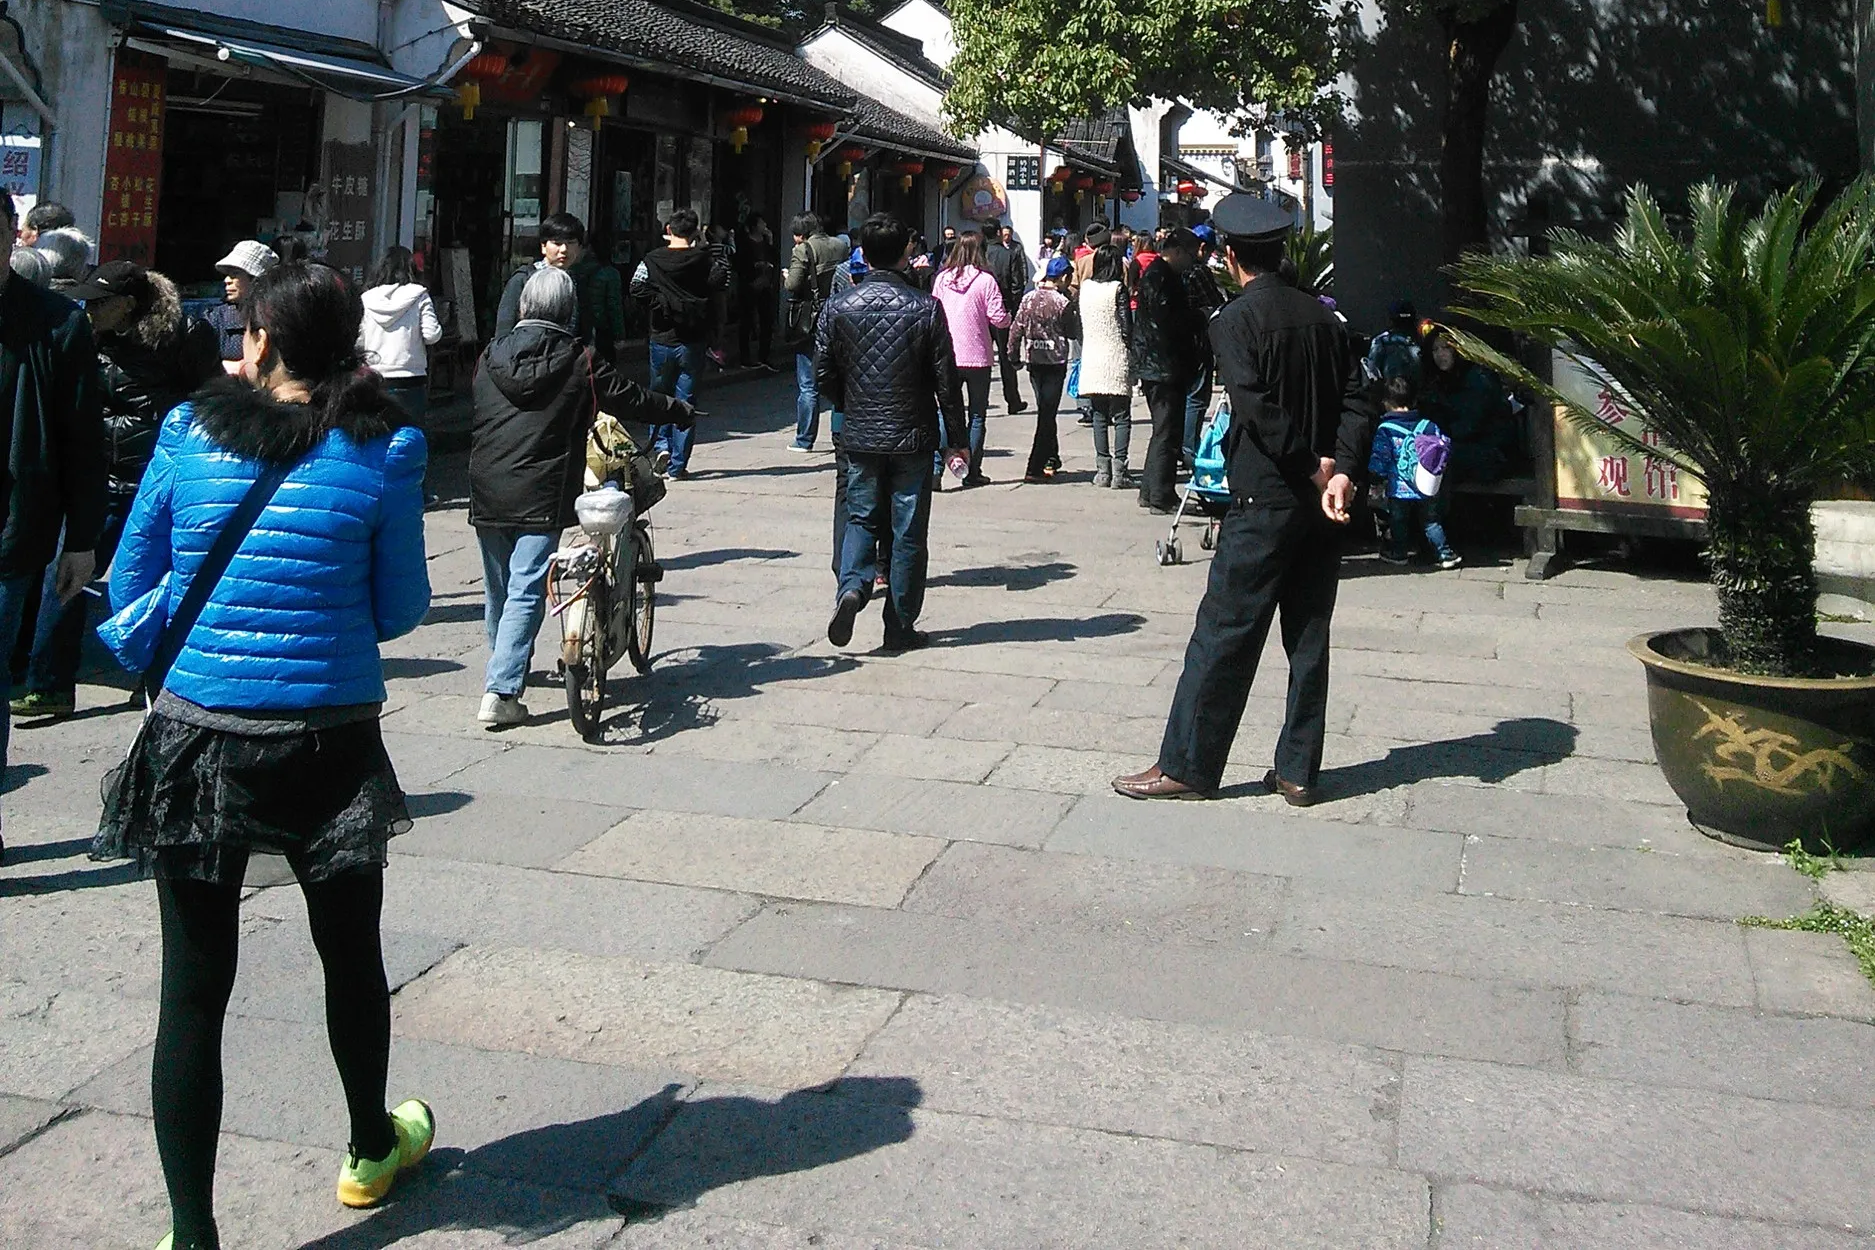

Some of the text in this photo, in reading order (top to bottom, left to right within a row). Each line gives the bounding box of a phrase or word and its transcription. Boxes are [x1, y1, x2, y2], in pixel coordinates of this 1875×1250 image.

[331, 174, 369, 197] 牛皮糖
[329, 220, 366, 241] 花生酥
[1594, 385, 1632, 497] 参观
